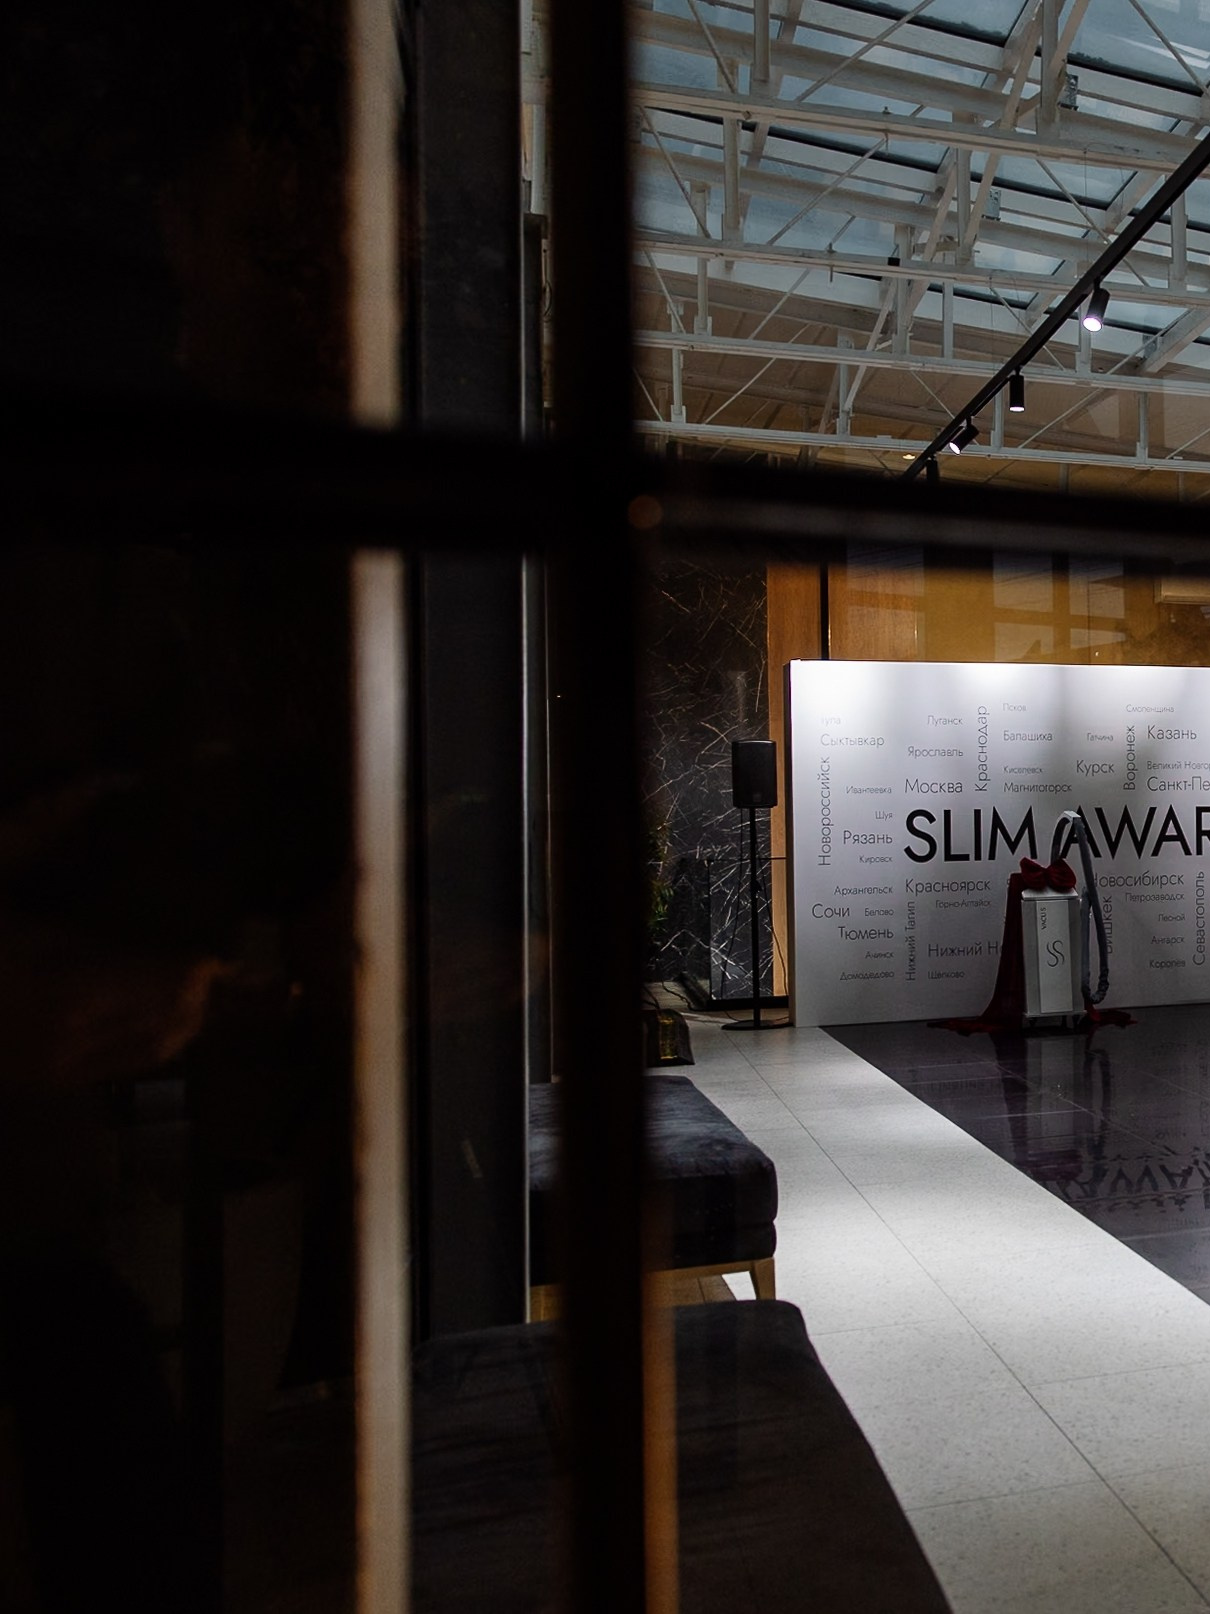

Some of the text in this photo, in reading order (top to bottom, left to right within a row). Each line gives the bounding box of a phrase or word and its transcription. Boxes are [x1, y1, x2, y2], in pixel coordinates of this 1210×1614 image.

[1002, 702, 1027, 712] Псков
[927, 715, 963, 727] Луганск
[820, 733, 885, 748] Сыктывкар
[1003, 730, 1053, 741] Балашиха
[1147, 725, 1197, 741] Казань
[908, 746, 964, 758] Ярославль
[975, 705, 991, 792] Краснодар
[1123, 725, 1138, 791] Воронеж
[1147, 760, 1182, 771] Великий
[1076, 760, 1115, 776] Курск
[904, 779, 963, 794] Москва
[1003, 782, 1073, 795] Магнитогорск
[817, 756, 834, 866] Новороссийск
[875, 810, 893, 820] Шуя
[843, 830, 893, 845] Рязань
[903, 805, 1038, 863] SLIM
[859, 855, 893, 864] Кировск
[833, 885, 893, 897] Архангельск
[905, 878, 991, 896] Красноярск
[812, 903, 850, 919] Сочи
[864, 907, 894, 917] Белово
[1193, 871, 1206, 966] Севастополь
[838, 926, 894, 940] Тюмень
[1151, 935, 1185, 946] Ангарск
[905, 901, 917, 981] Нижний Тагил
[928, 941, 983, 957] Нижний
